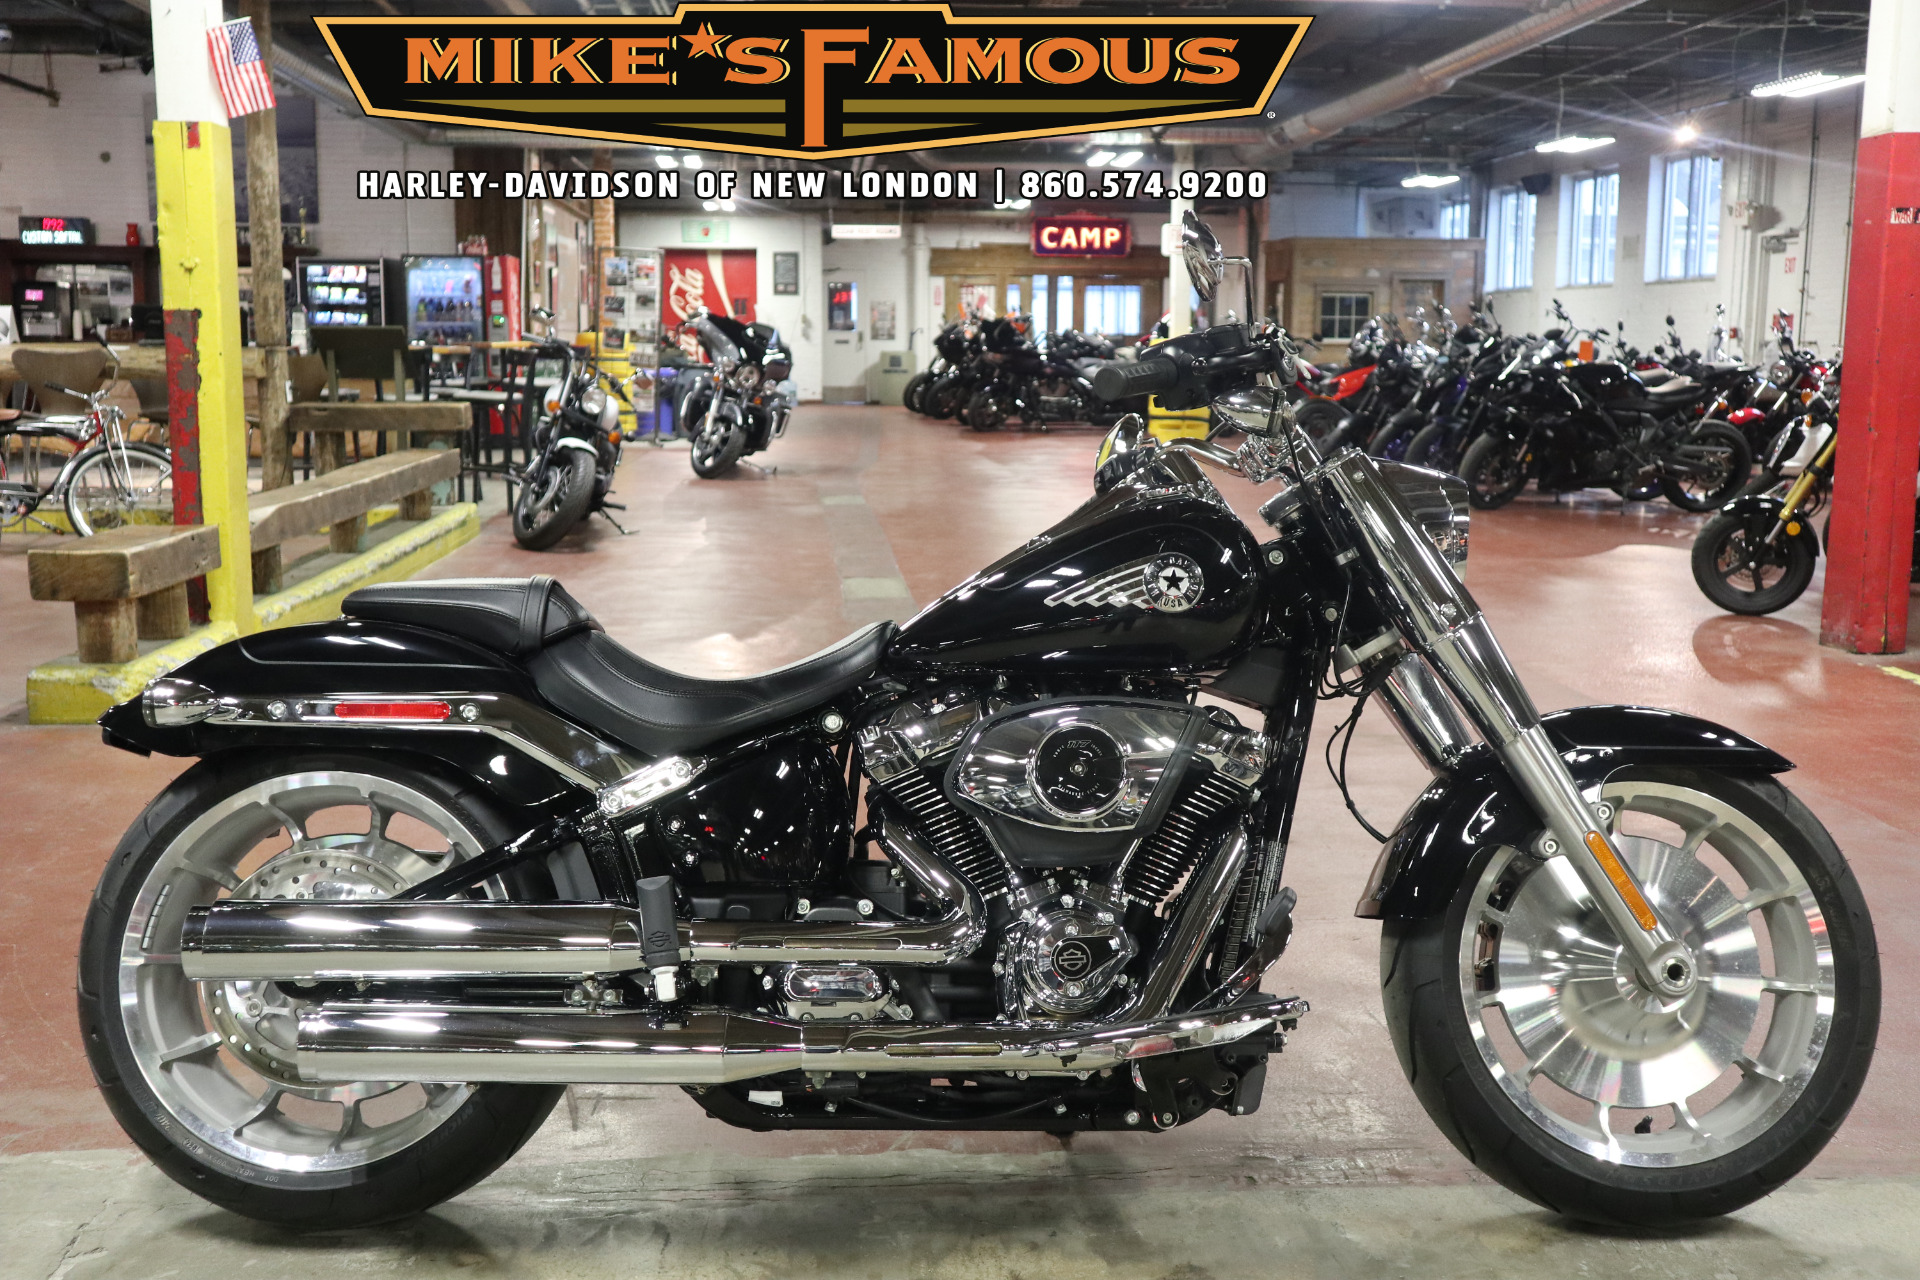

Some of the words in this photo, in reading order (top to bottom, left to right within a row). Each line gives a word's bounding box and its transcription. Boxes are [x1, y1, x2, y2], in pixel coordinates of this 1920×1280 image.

[1040, 226, 1121, 249] CAMP
[1784, 257, 1797, 274] EXIT
[1163, 597, 1183, 609] USA
